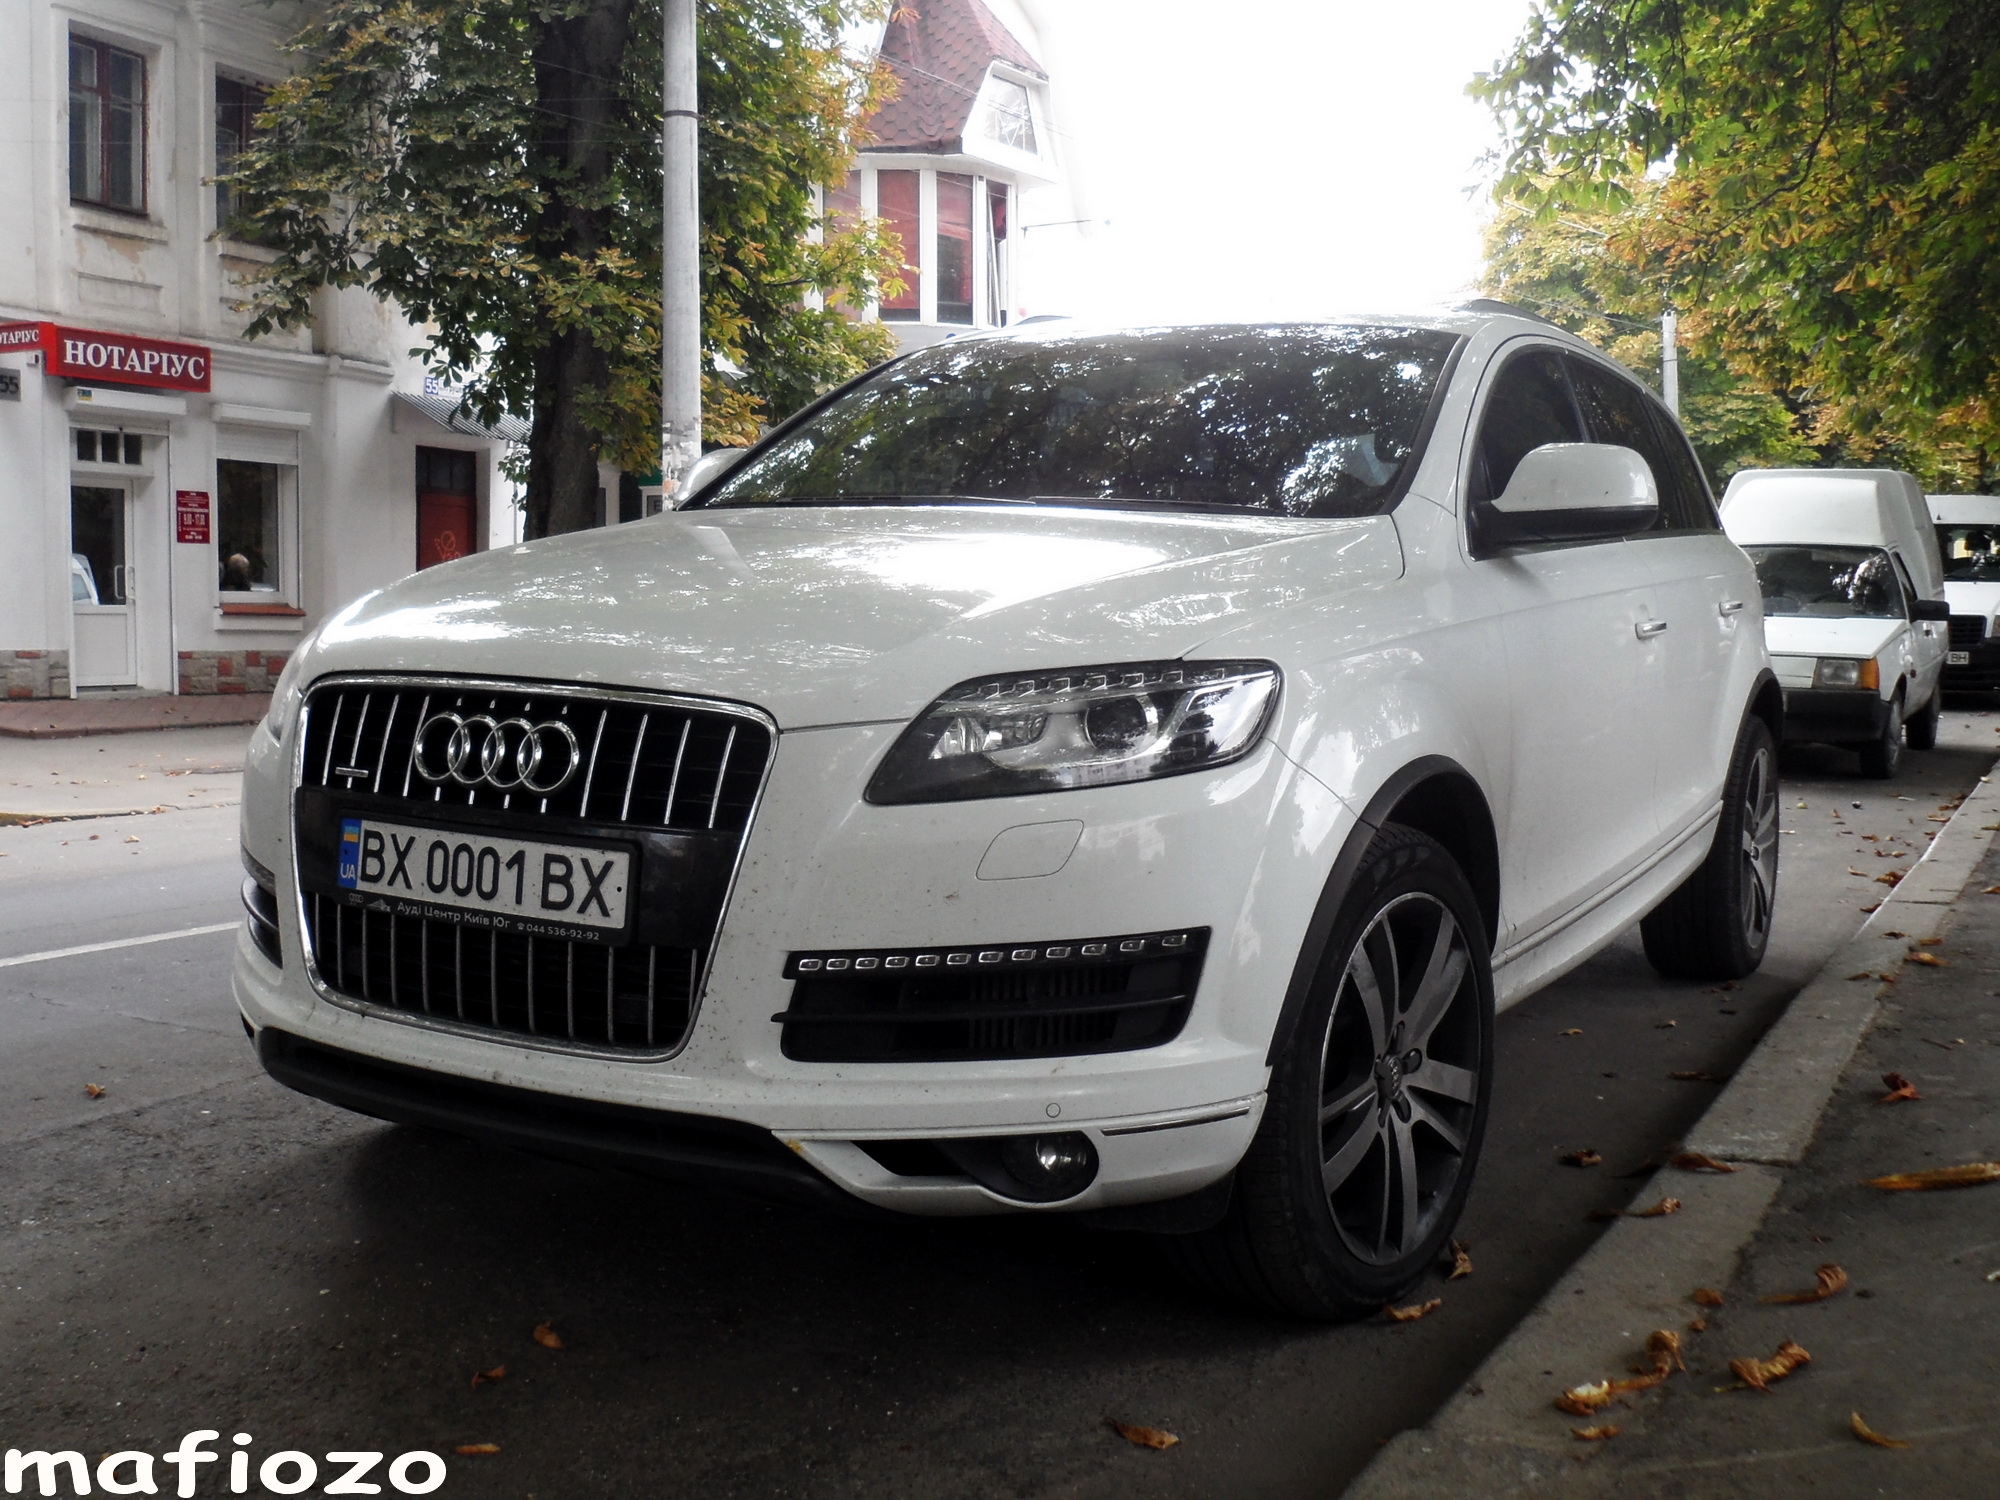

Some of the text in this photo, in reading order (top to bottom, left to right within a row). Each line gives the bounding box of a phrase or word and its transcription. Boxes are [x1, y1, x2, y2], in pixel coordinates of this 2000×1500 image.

[63, 339, 205, 380] НОТАРІУС
[425, 378, 438, 394] 55
[340, 863, 356, 880] UA
[360, 829, 614, 917] BX 0001 BX
[397, 901, 511, 929] Ауді Центр Київ Юг
[526, 923, 600, 941] 044 536-92-92
